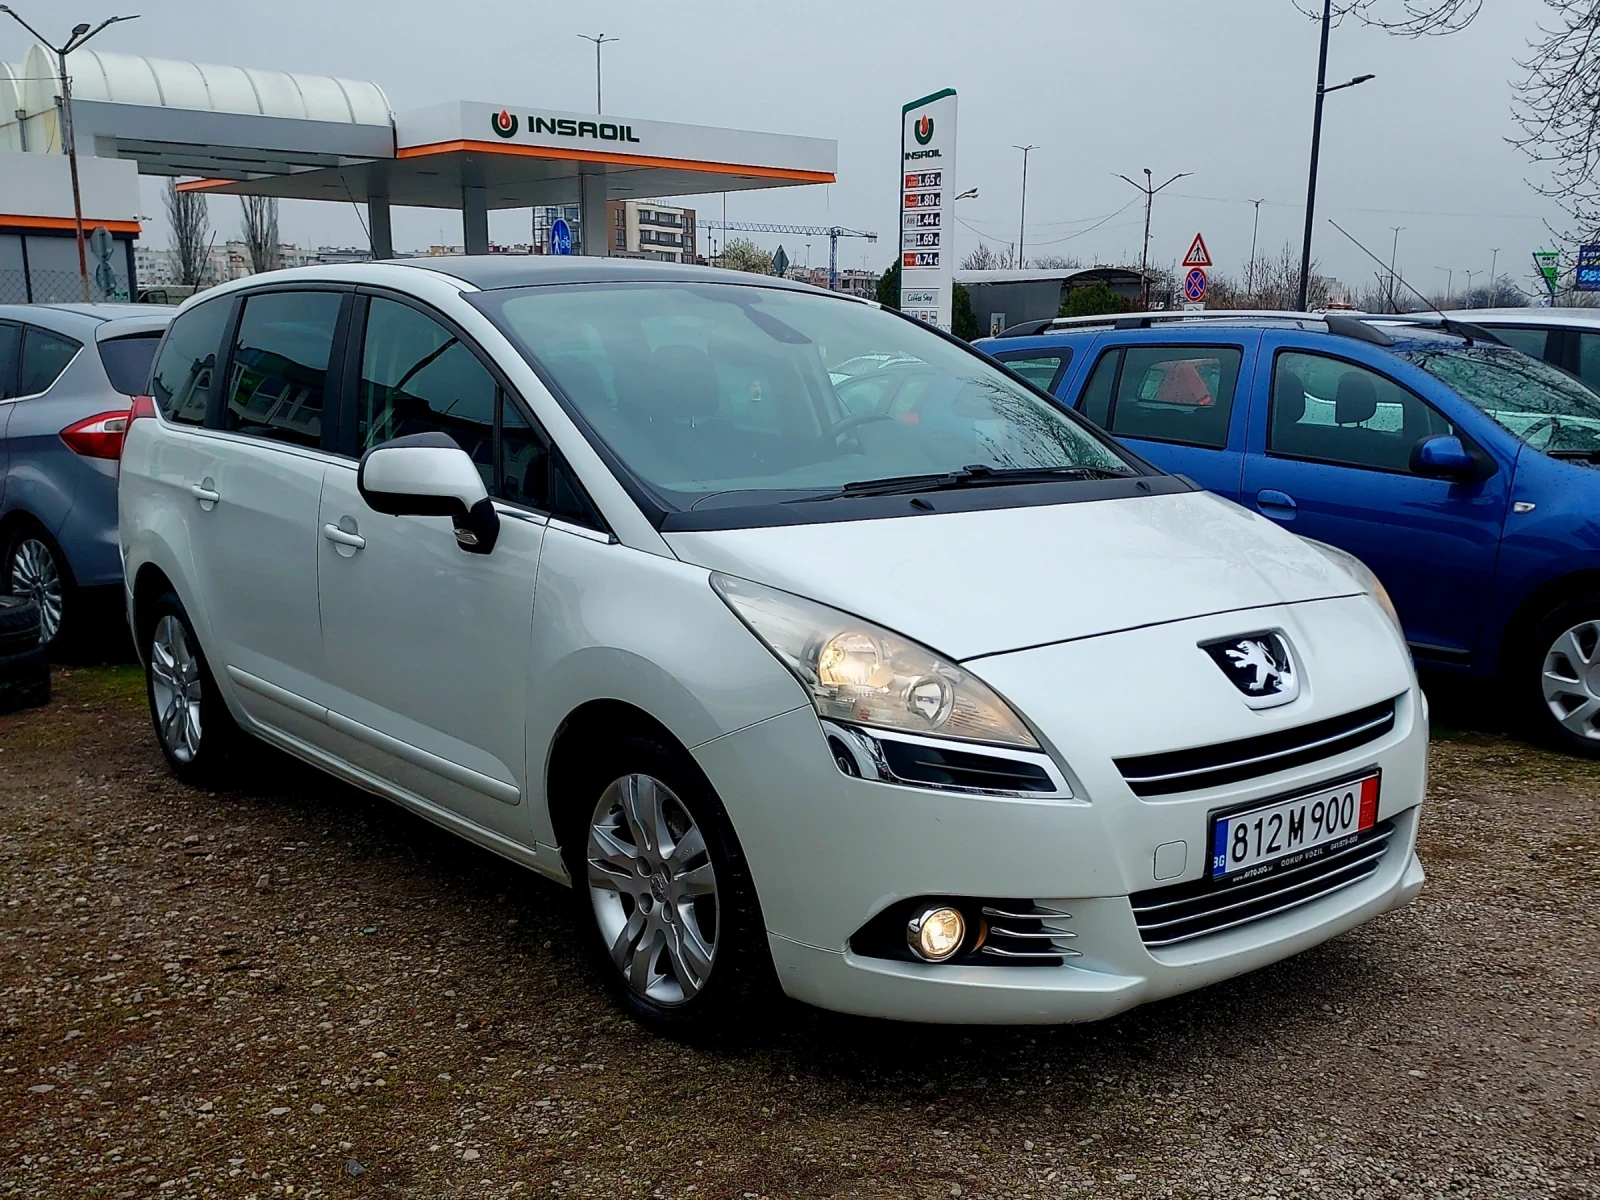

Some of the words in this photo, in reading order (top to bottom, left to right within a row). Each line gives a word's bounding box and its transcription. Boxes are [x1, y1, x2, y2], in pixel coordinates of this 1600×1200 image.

[528, 116, 640, 143] INSAOIL
[905, 149, 943, 161] INSAOIL
[918, 174, 935, 187] 1.65
[917, 194, 935, 206] 1.80
[917, 213, 935, 226] 1.44
[916, 233, 934, 245] 1.69
[915, 254, 933, 266] 0.74
[1280, 854, 1304, 867] ODKUP
[1304, 847, 1324, 860] VOZIL
